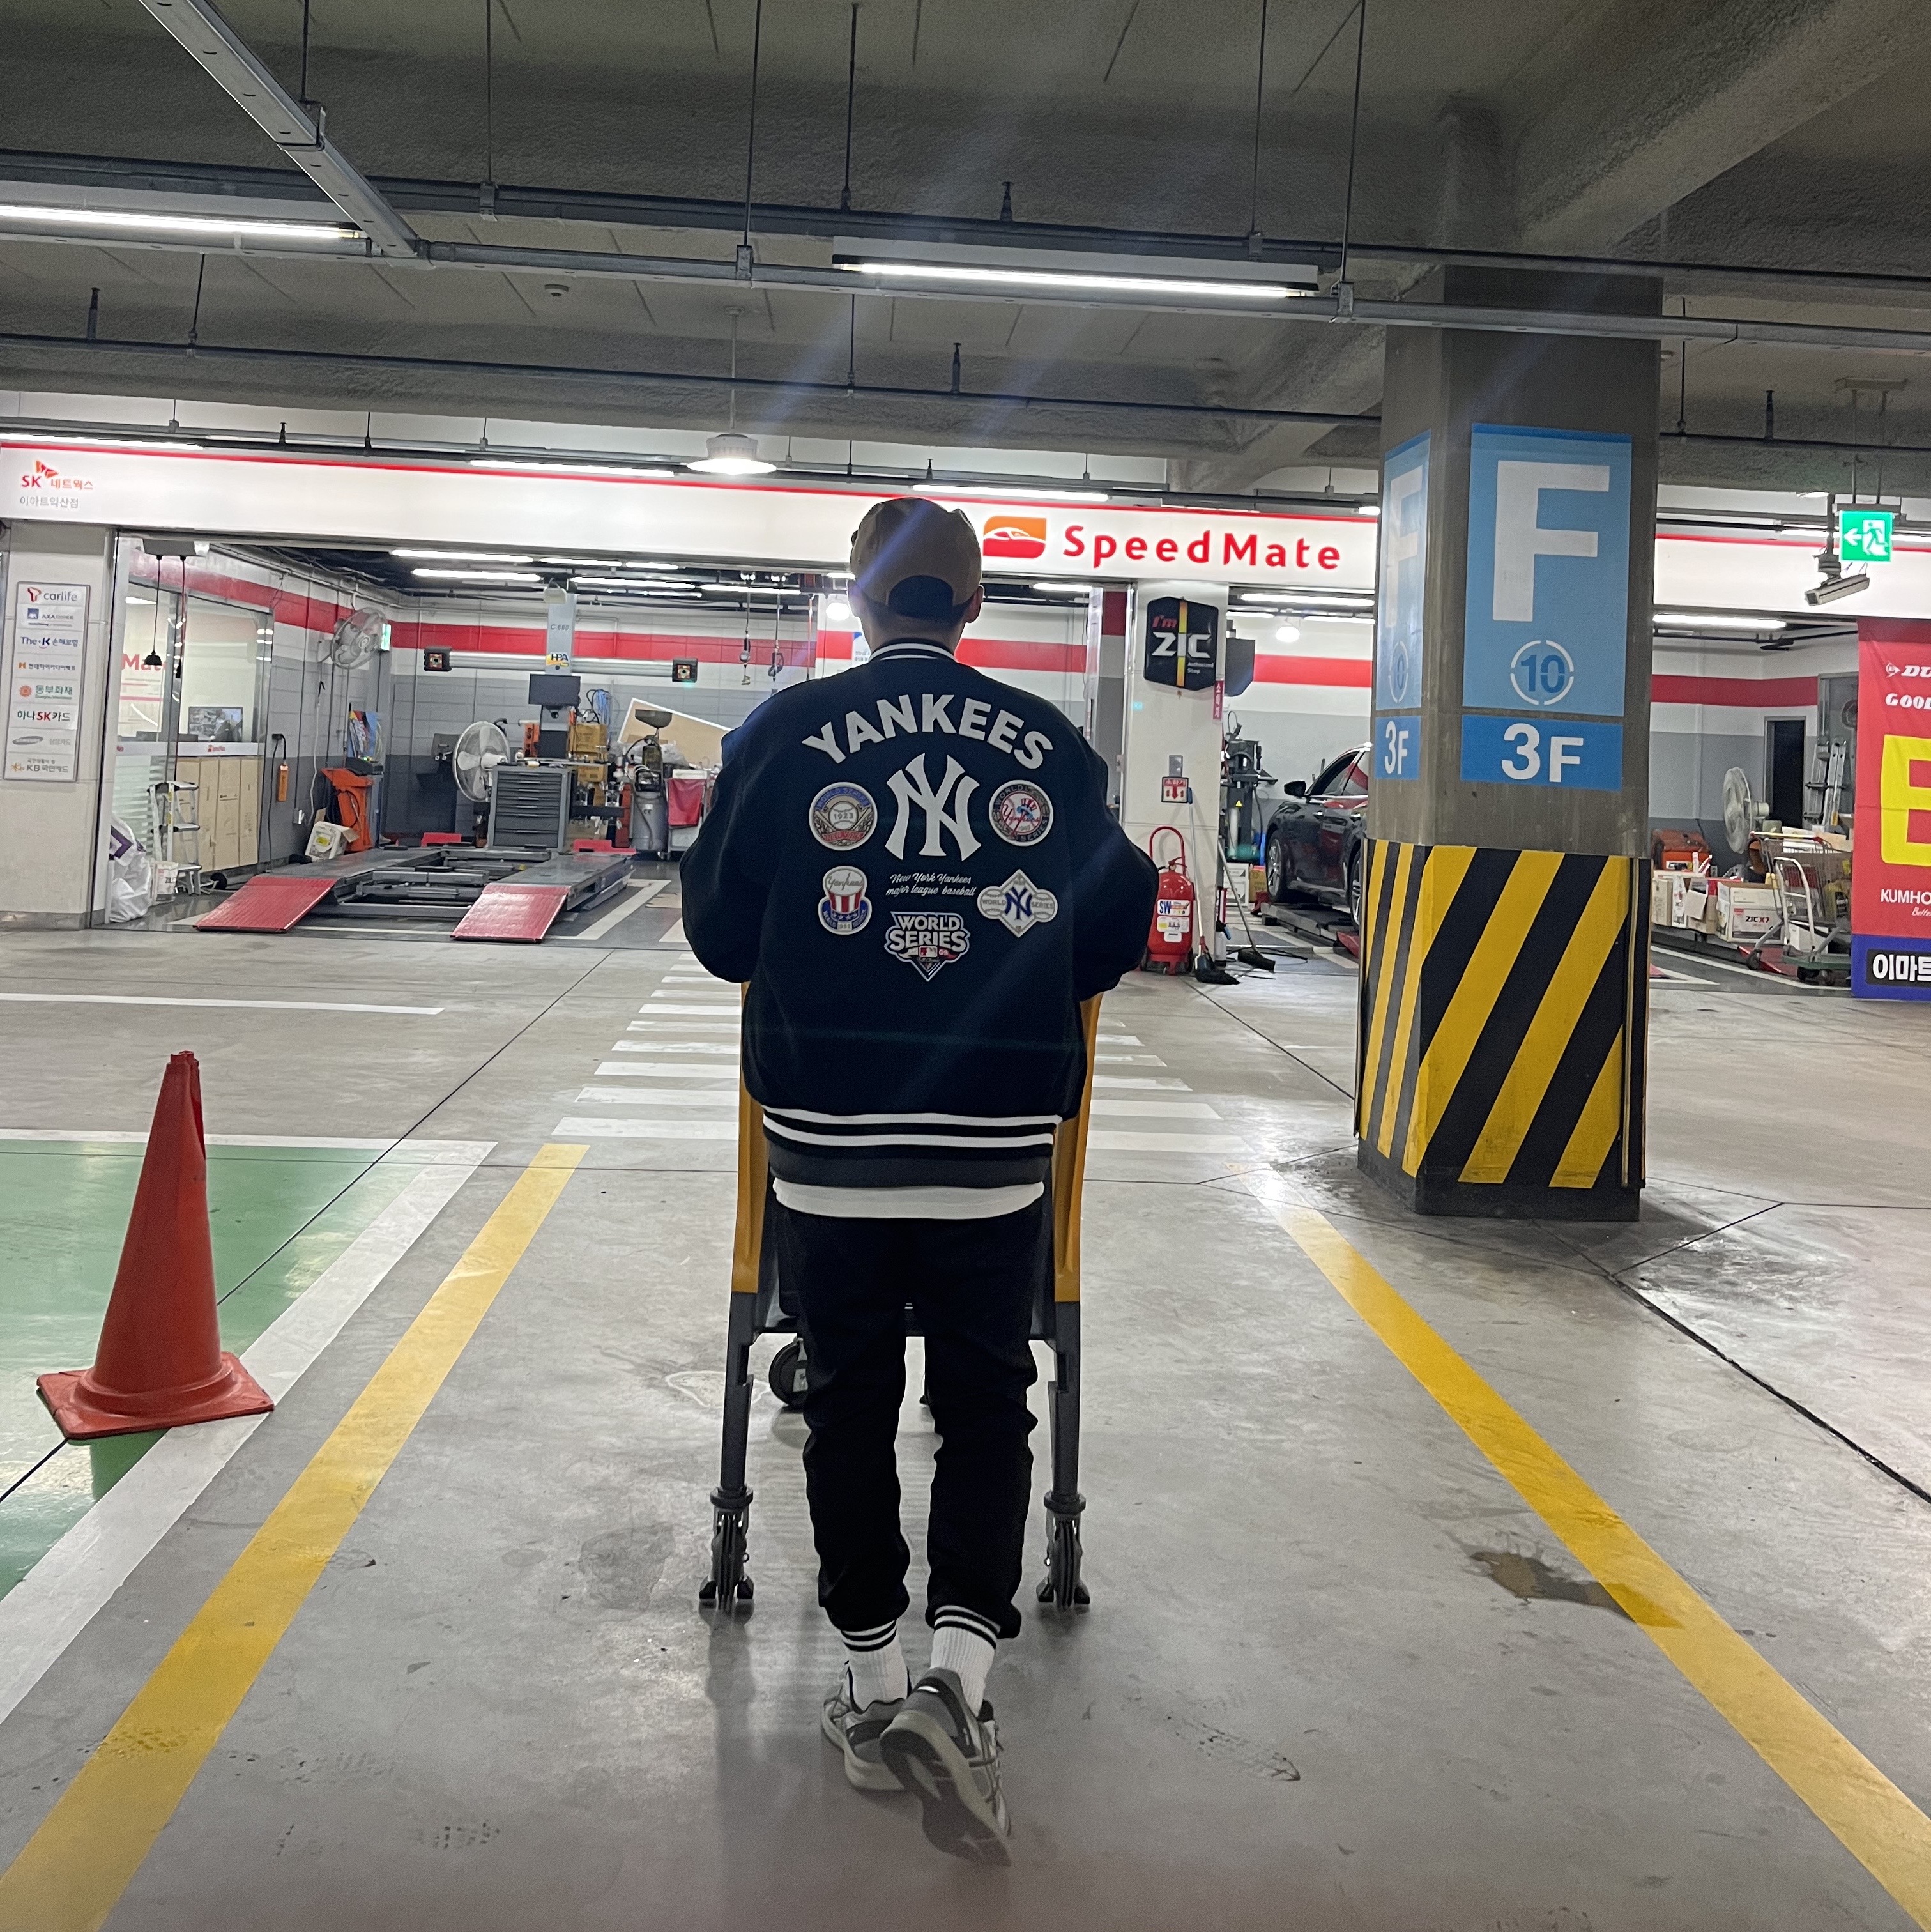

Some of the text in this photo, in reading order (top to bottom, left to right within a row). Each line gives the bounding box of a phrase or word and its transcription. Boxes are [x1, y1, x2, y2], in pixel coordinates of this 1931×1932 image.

[22, 475, 93, 490] SK 네트웍스
[20, 496, 79, 509] 이마트익산점
[1385, 466, 1423, 629] F
[1492, 460, 1610, 622] F
[43, 591, 77, 602] carlife
[1152, 615, 1177, 628] I'm
[1152, 631, 1212, 659] ZIC
[121, 654, 168, 671] Ma
[1520, 654, 1566, 694] 10
[802, 694, 1053, 769] YANKEES
[1385, 721, 1409, 775] 3F
[1501, 723, 1584, 783] 3F
[890, 872, 972, 884] New York Yankees
[885, 884, 977, 897] major league baseball
[1881, 889, 1931, 905] KUMHO
[1159, 901, 1172, 914] SW
[897, 915, 961, 931] WORLD
[889, 929, 966, 952] SERIES
